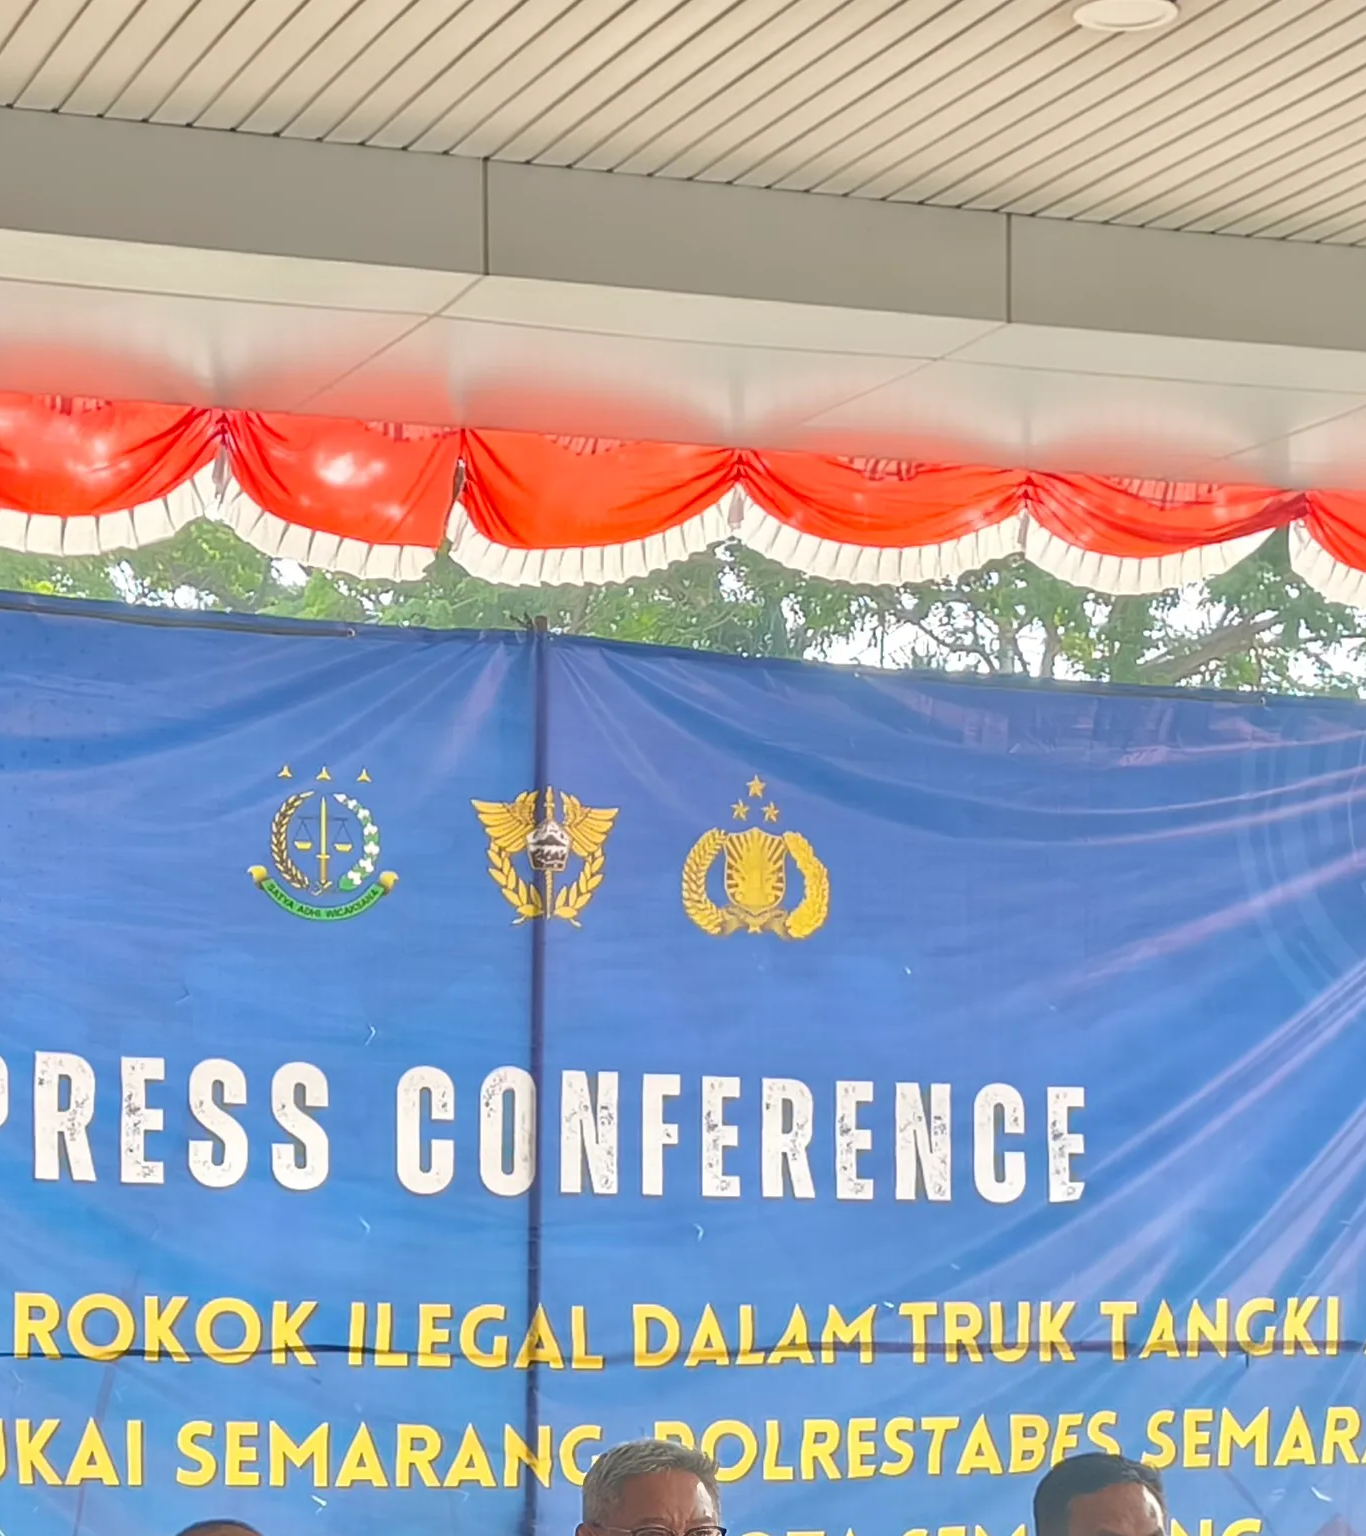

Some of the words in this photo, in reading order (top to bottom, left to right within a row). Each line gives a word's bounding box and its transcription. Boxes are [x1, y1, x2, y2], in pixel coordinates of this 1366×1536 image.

[397, 1066, 1085, 1203] CONFERENCE
[14, 1293, 317, 1365] ROKOK
[347, 1303, 605, 1370] ILEGAL
[632, 1304, 877, 1368] DALAM
[899, 1302, 1076, 1364] TRUK
[1099, 1298, 1341, 1361] TANGKI
